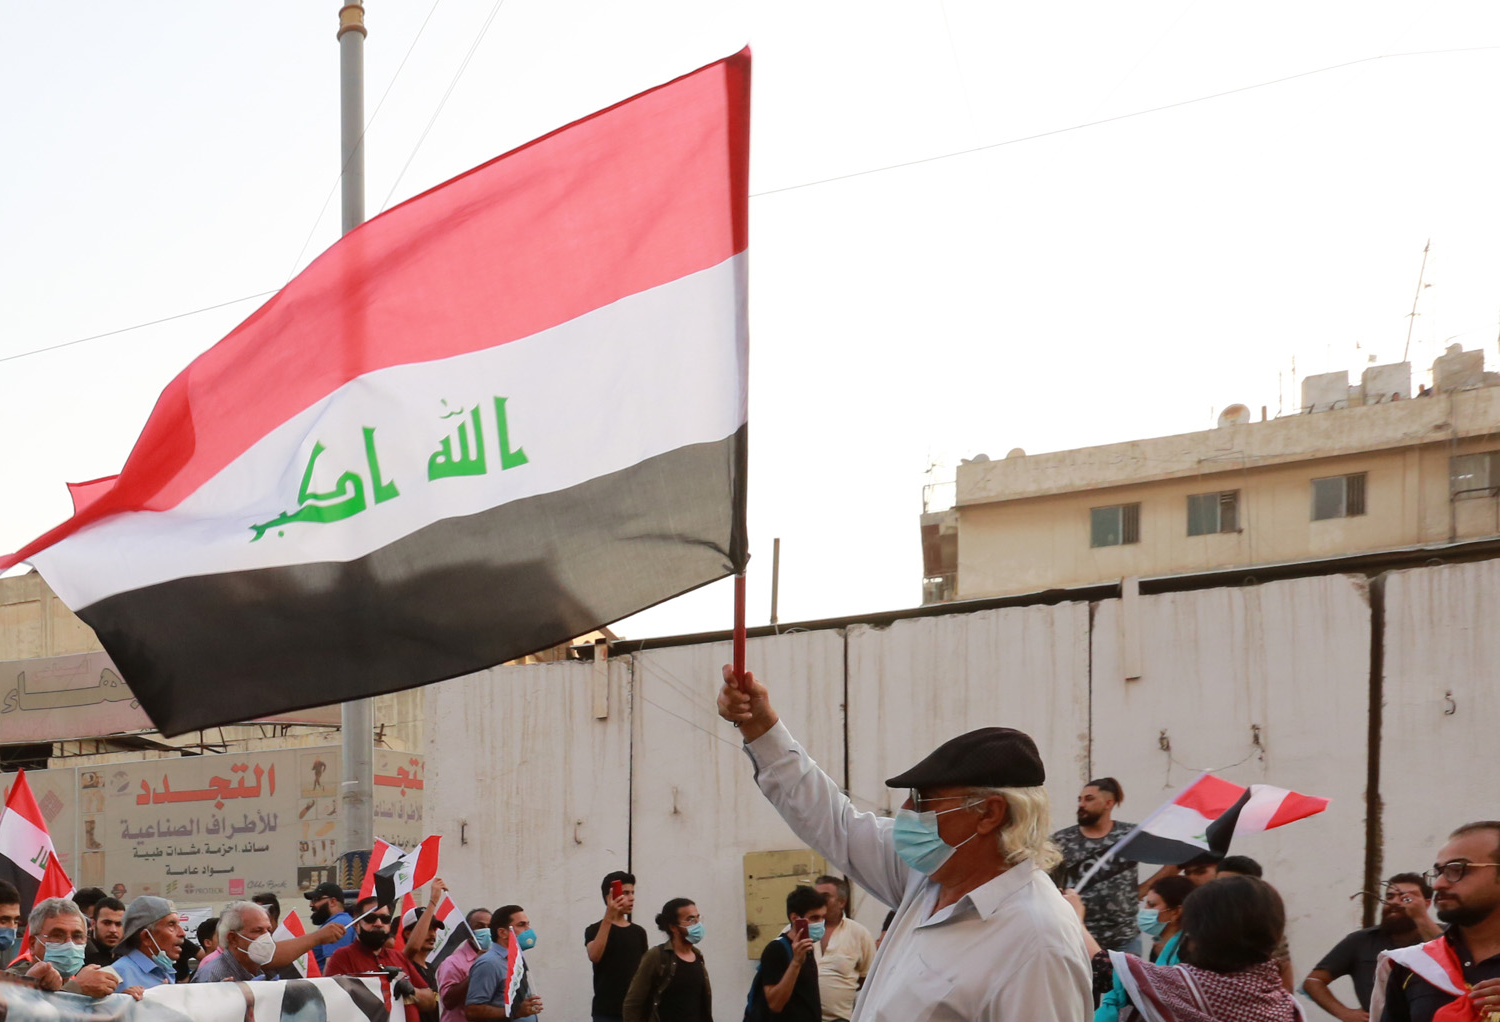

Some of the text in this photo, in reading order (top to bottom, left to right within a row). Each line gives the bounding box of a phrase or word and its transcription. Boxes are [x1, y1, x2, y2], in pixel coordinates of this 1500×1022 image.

[428, 396, 529, 482] الله
[136, 762, 276, 811] التجدد
[120, 808, 278, 846] للأطراف الصناعية
[165, 863, 235, 877] مواد عامة
